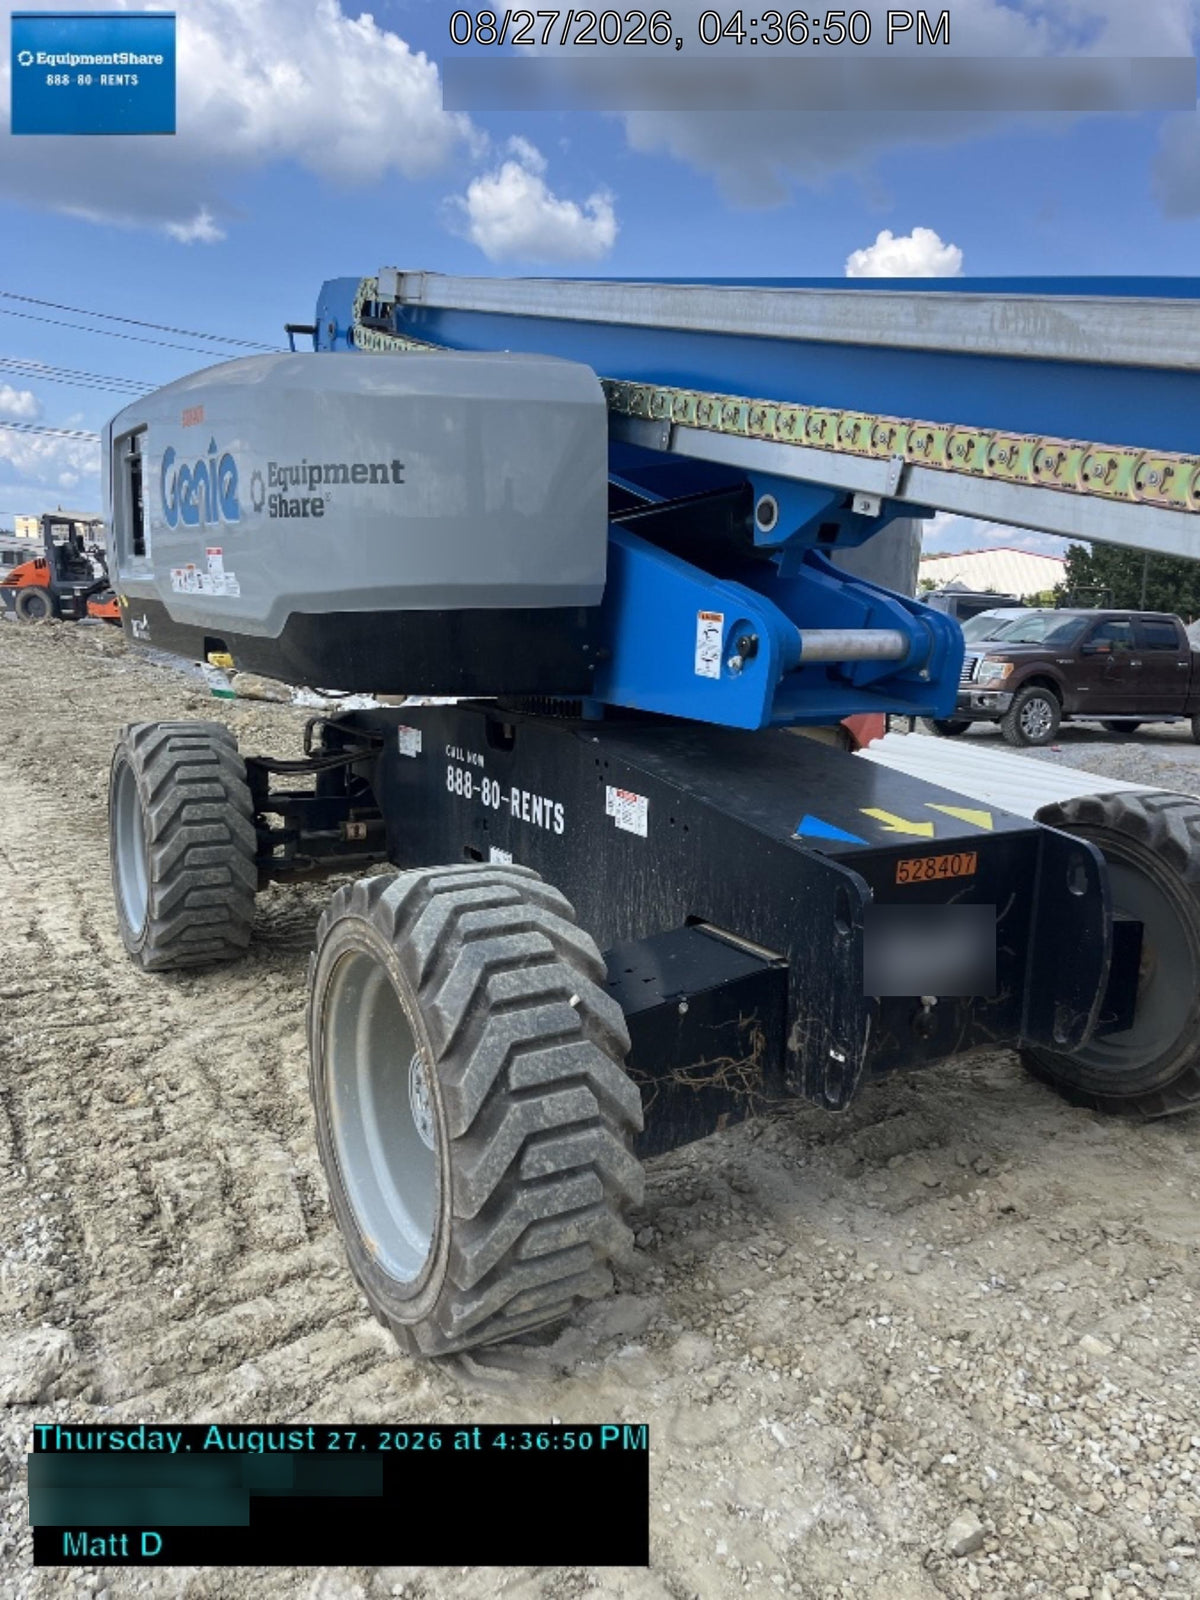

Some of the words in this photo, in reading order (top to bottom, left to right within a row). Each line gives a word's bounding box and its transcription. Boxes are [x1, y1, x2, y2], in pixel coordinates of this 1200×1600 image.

[161, 436, 240, 529] Genie
[267, 458, 406, 492] Equipment
[267, 492, 325, 519] Share
[446, 765, 565, 835] 888-80-RENTS
[898, 853, 976, 882] 528407
